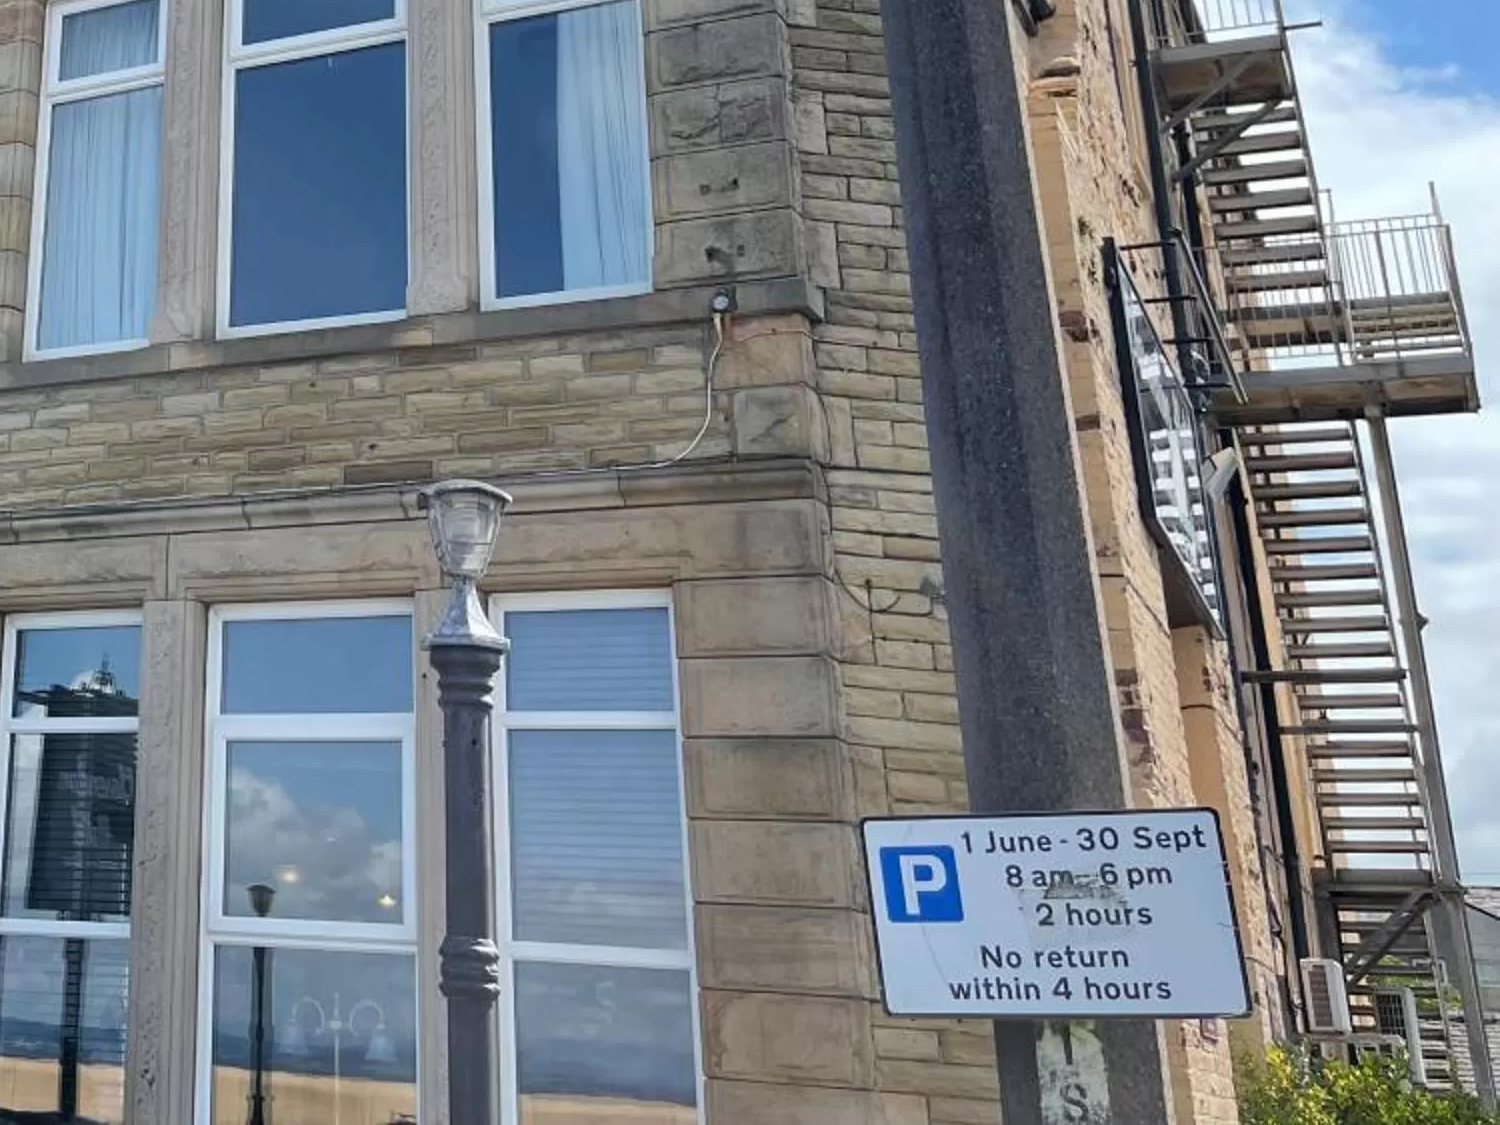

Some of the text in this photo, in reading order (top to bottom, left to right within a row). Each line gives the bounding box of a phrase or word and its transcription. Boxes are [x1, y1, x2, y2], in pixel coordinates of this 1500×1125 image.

[961, 831, 973, 854] 1
[985, 830, 1052, 854] June
[1076, 827, 1119, 852] 30
[1133, 824, 1207, 853] Sept
[1005, 864, 1024, 888] 8
[1031, 870, 1074, 888] am
[1100, 862, 1119, 886] 6
[1126, 866, 1173, 890] pm
[1035, 902, 1153, 927] 2 hours
[980, 944, 1129, 969] No return
[949, 976, 1172, 1001] within 4 hours
